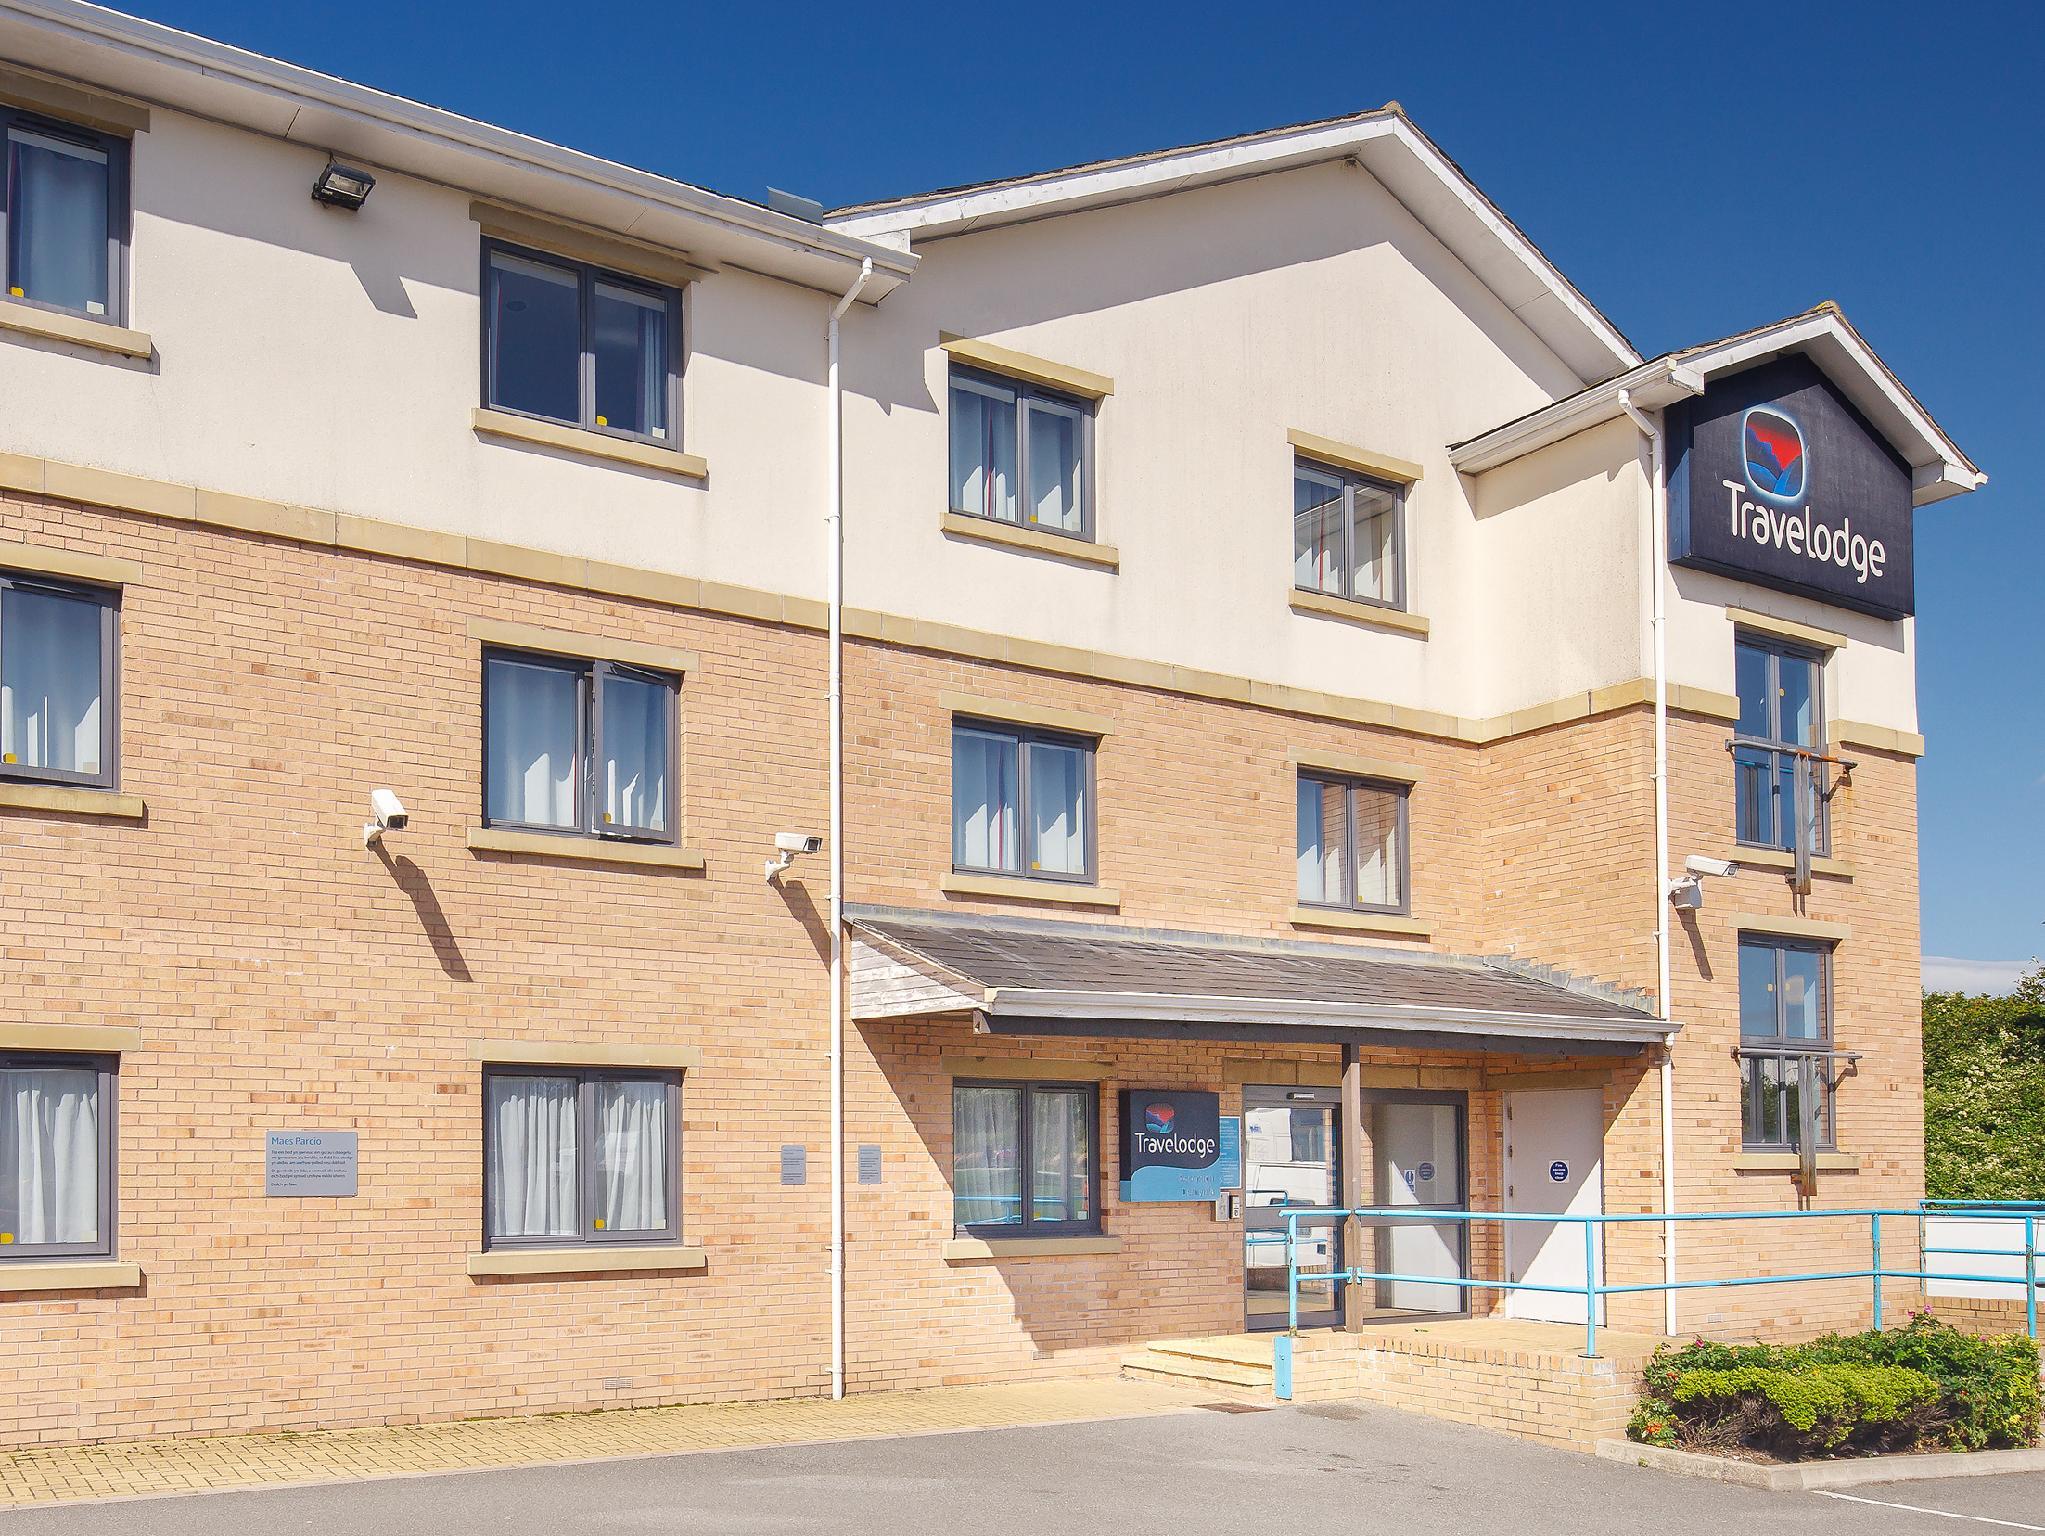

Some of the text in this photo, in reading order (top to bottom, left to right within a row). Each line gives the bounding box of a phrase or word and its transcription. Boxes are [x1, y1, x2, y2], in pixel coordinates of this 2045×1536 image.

[1722, 479, 1886, 584] Travelodge
[271, 1136, 322, 1145] Maes Parcio
[1134, 1132, 1216, 1159] Travelodge
